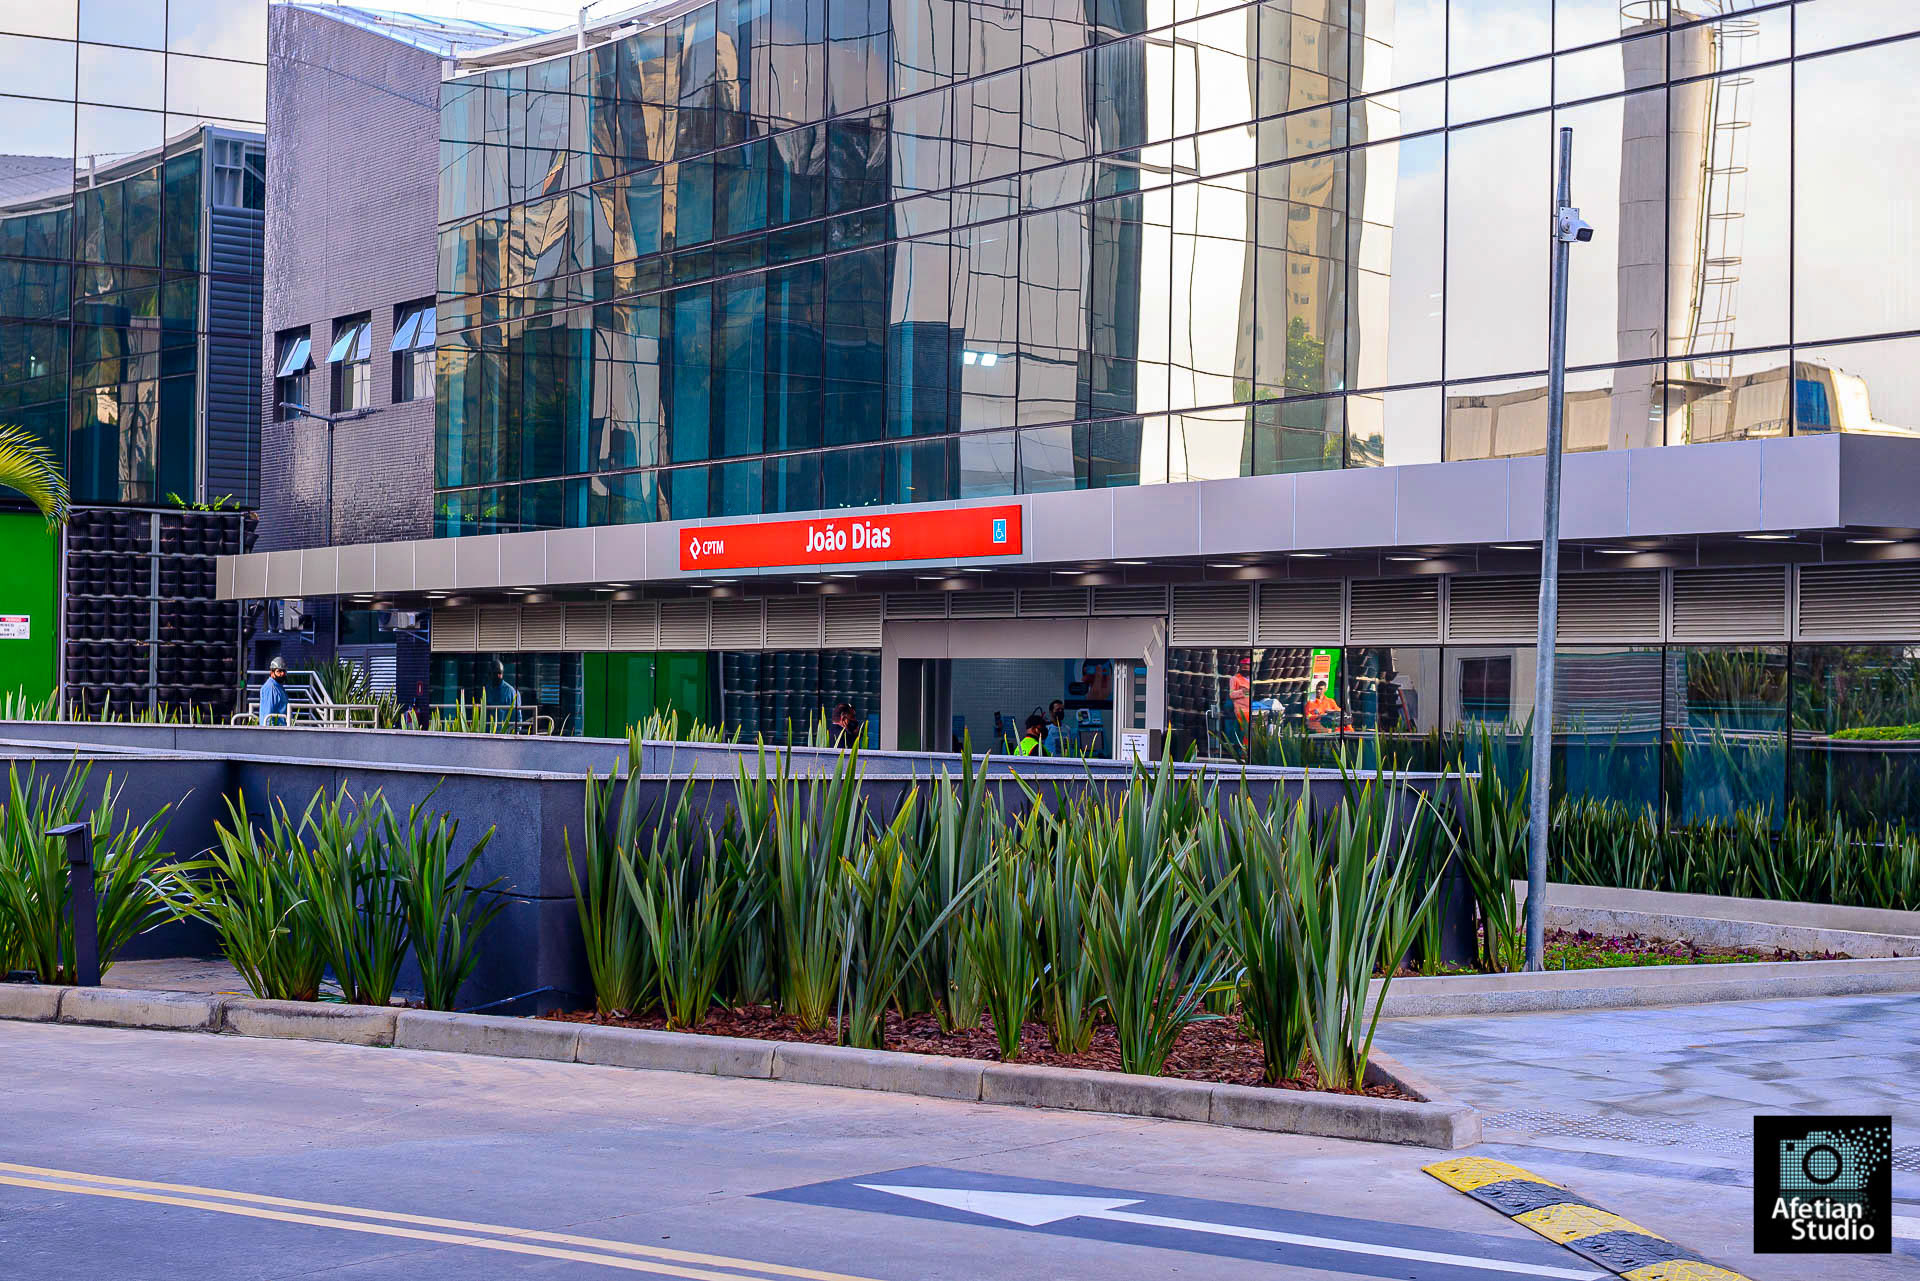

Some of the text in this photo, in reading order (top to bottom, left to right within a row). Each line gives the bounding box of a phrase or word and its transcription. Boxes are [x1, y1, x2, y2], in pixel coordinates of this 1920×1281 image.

[702, 540, 725, 555] CPTM
[806, 521, 891, 552] João Dias
